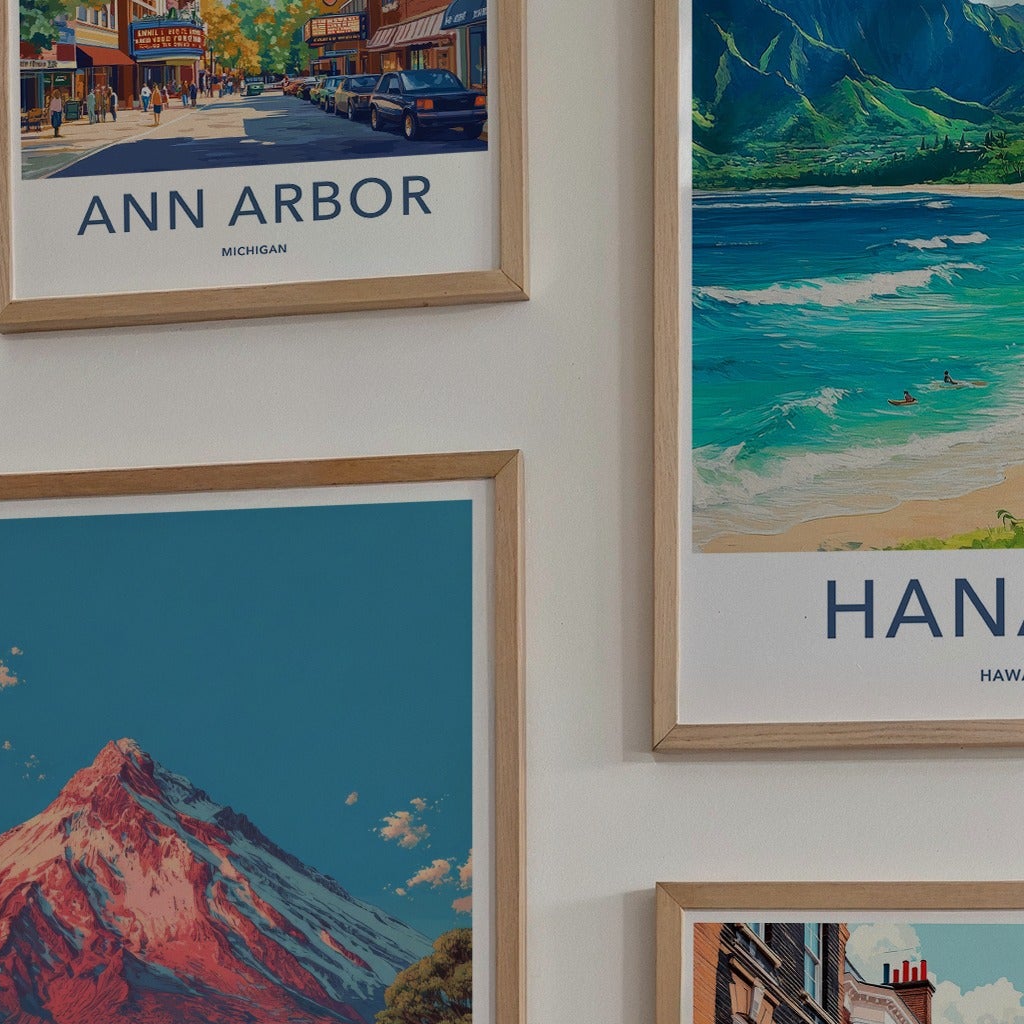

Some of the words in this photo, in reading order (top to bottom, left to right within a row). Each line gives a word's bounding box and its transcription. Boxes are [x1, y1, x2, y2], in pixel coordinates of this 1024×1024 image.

[77, 189, 204, 236] ANN
[228, 175, 432, 226] ARBOR
[222, 243, 287, 257] MICHIGAN
[827, 577, 1024, 639] HAN
[980, 668, 1024, 682] HAW
